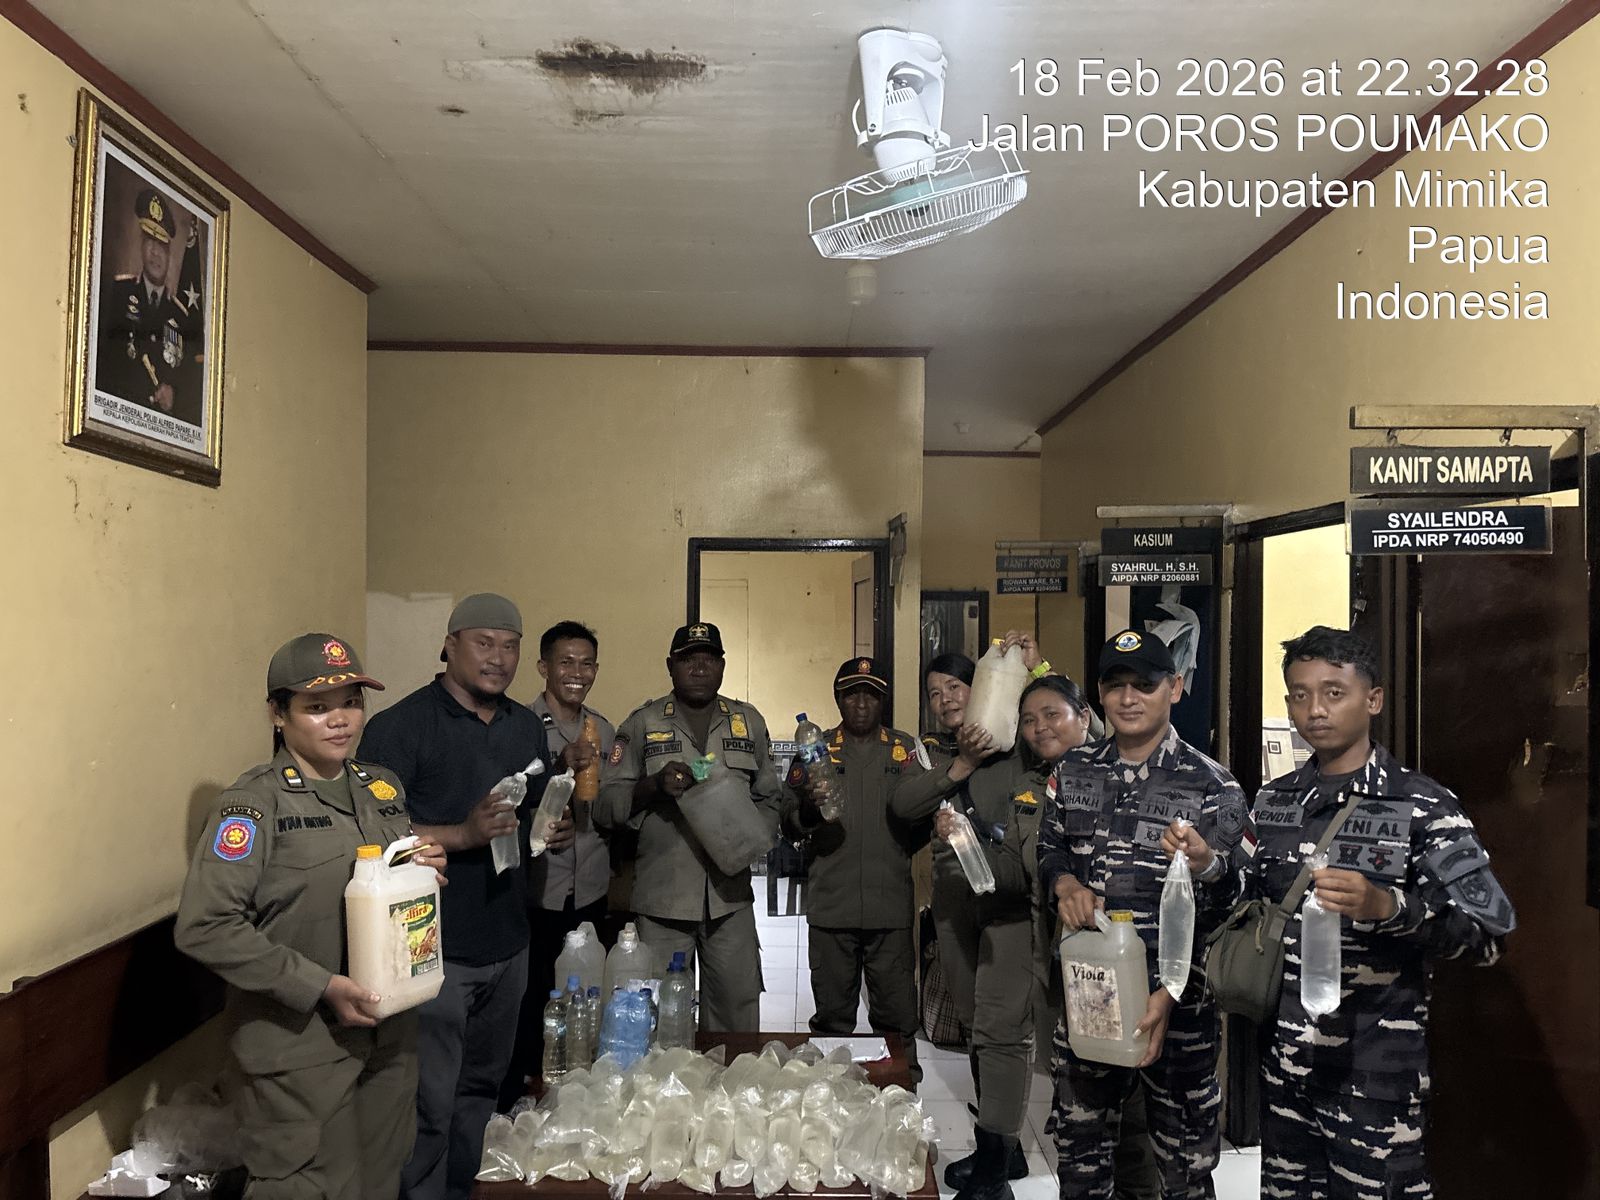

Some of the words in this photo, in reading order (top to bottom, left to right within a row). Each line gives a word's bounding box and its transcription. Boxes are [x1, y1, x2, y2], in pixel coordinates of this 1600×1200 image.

[94, 394, 118, 409] BRIGADIR
[119, 404, 143, 419] JENDERAL
[103, 409, 121, 420] KEPALA
[1369, 455, 1433, 484] KANIT
[1436, 455, 1534, 484] SAMAPTA
[1387, 510, 1509, 529] SYAILENDRA
[1133, 533, 1174, 547] KASIUM
[1373, 533, 1412, 548] IPDA
[1415, 533, 1450, 547] NRP
[1453, 531, 1525, 546] 74050490
[1003, 558, 1028, 569] KANIT
[1028, 557, 1062, 569] PROVOS
[1111, 562, 1163, 572] SYAHRUL.
[1178, 562, 1200, 572] S.H.
[1111, 574, 1139, 583] AIPDA
[1140, 574, 1160, 582] NRP
[1161, 573, 1200, 582] 82060881
[1146, 804, 1170, 818] TNI
[1343, 818, 1372, 835] TNI
[1376, 821, 1401, 838] AL
